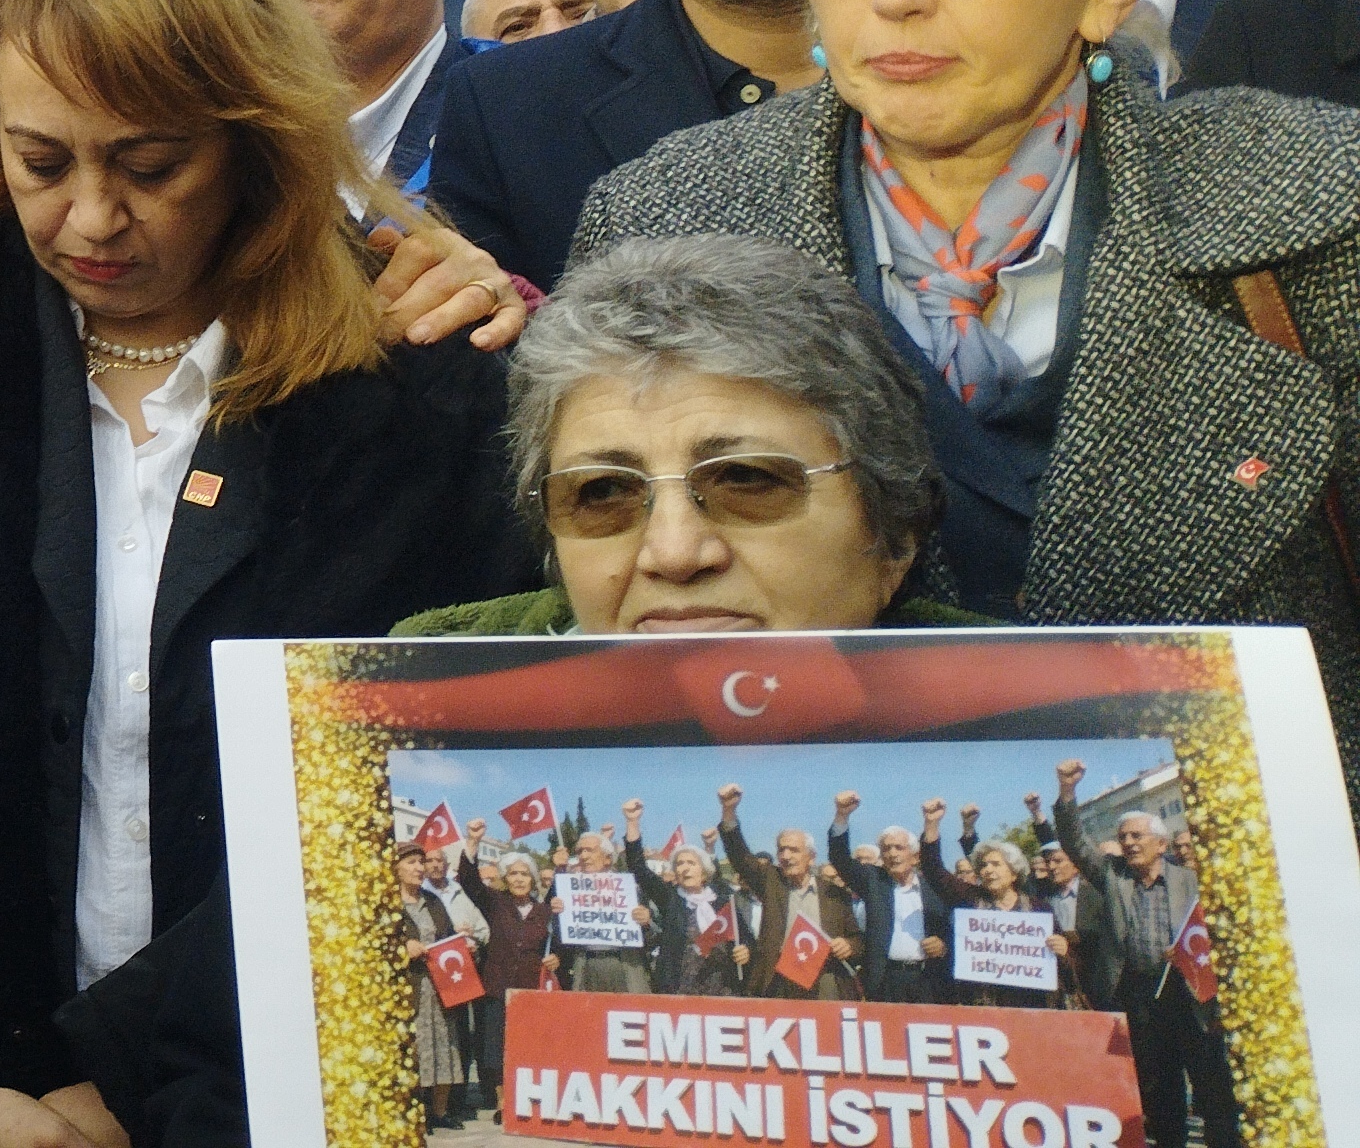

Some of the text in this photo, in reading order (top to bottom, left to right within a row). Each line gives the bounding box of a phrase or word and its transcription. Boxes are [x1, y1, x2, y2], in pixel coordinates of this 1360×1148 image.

[971, 956, 1043, 979] istiyoruz
[607, 1008, 1017, 1084] EMEKLİLER
[515, 1066, 1123, 1148] HAKKINI İSTİYOR
